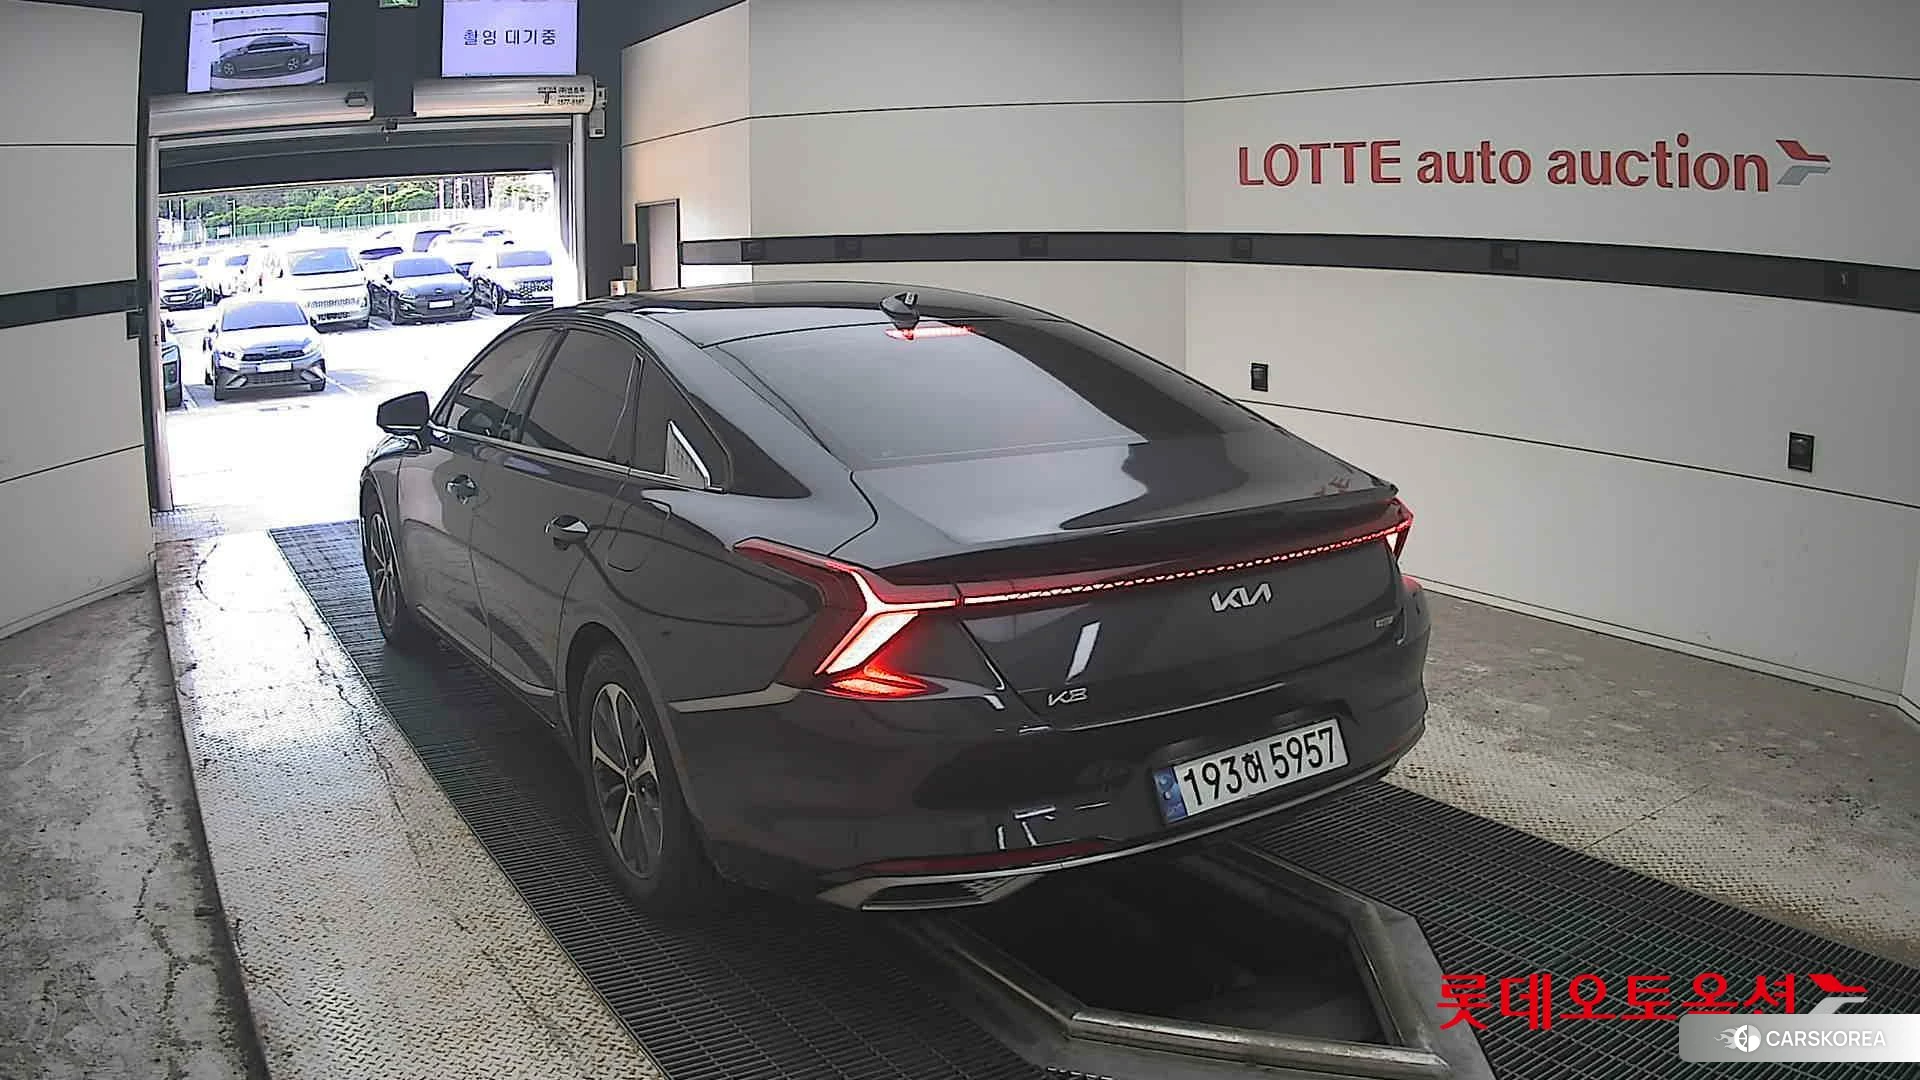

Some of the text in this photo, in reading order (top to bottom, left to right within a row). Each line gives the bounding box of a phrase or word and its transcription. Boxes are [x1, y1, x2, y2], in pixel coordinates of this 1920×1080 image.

[464, 29, 556, 46] 촬영 대기중
[1239, 132, 1769, 193] LOTTE auto auction
[1211, 583, 1273, 612] KIA
[1048, 687, 1088, 706] K8
[1184, 727, 1334, 806] 193허 5957
